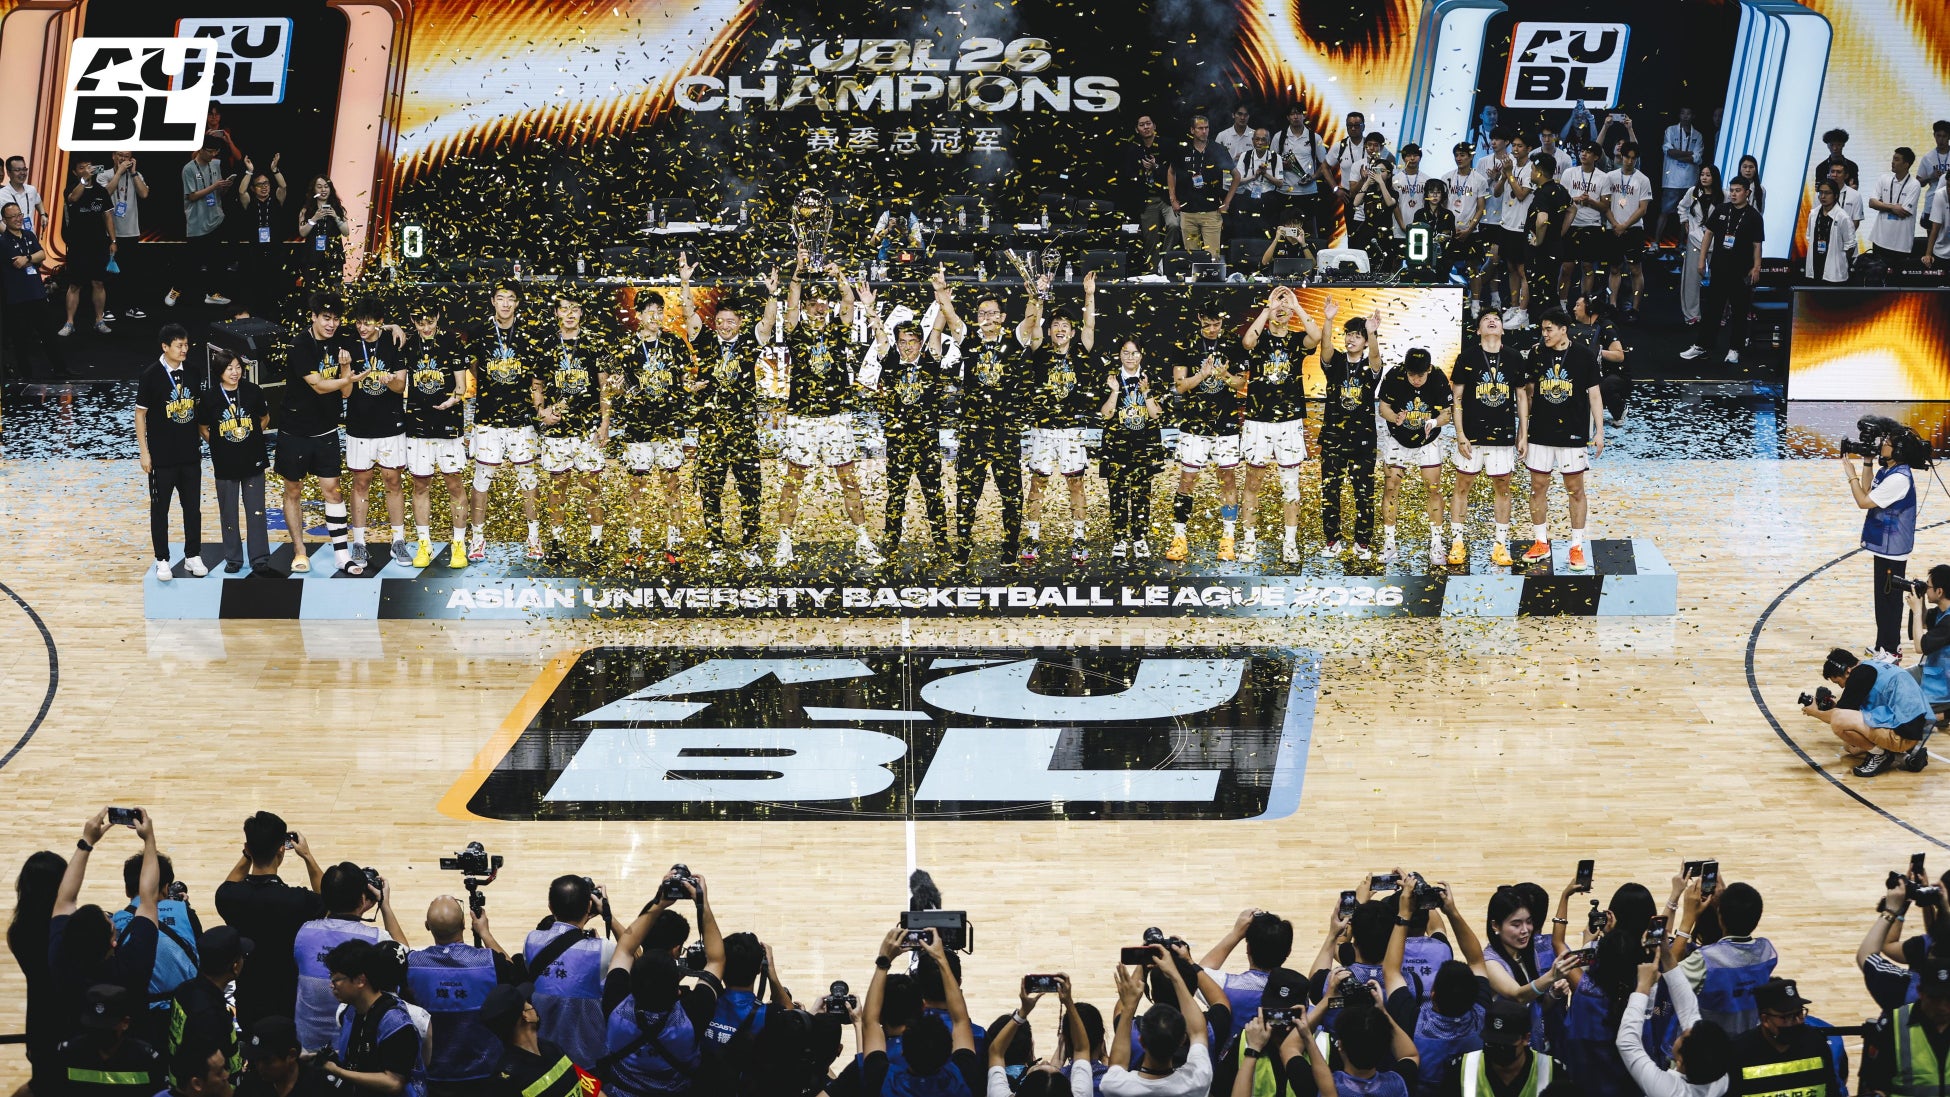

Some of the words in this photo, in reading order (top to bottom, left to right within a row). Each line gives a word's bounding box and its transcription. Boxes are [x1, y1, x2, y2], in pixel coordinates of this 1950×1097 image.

[758, 38, 1053, 72] AUBL26
[1517, 30, 1619, 63] AU
[673, 75, 1121, 112] CHAMPIONS
[1515, 66, 1609, 101] BL
[806, 126, 1003, 155] 赛季总冠军
[404, 226, 423, 258] 0
[1408, 228, 1428, 260] 0
[445, 588, 576, 608] ASIAN
[582, 588, 835, 609] UNIVERSITY
[842, 586, 1114, 608] BASKETBALL
[1121, 586, 1285, 607] LEAGUE
[1291, 586, 1404, 607] 2026
[542, 728, 1221, 802] BL
